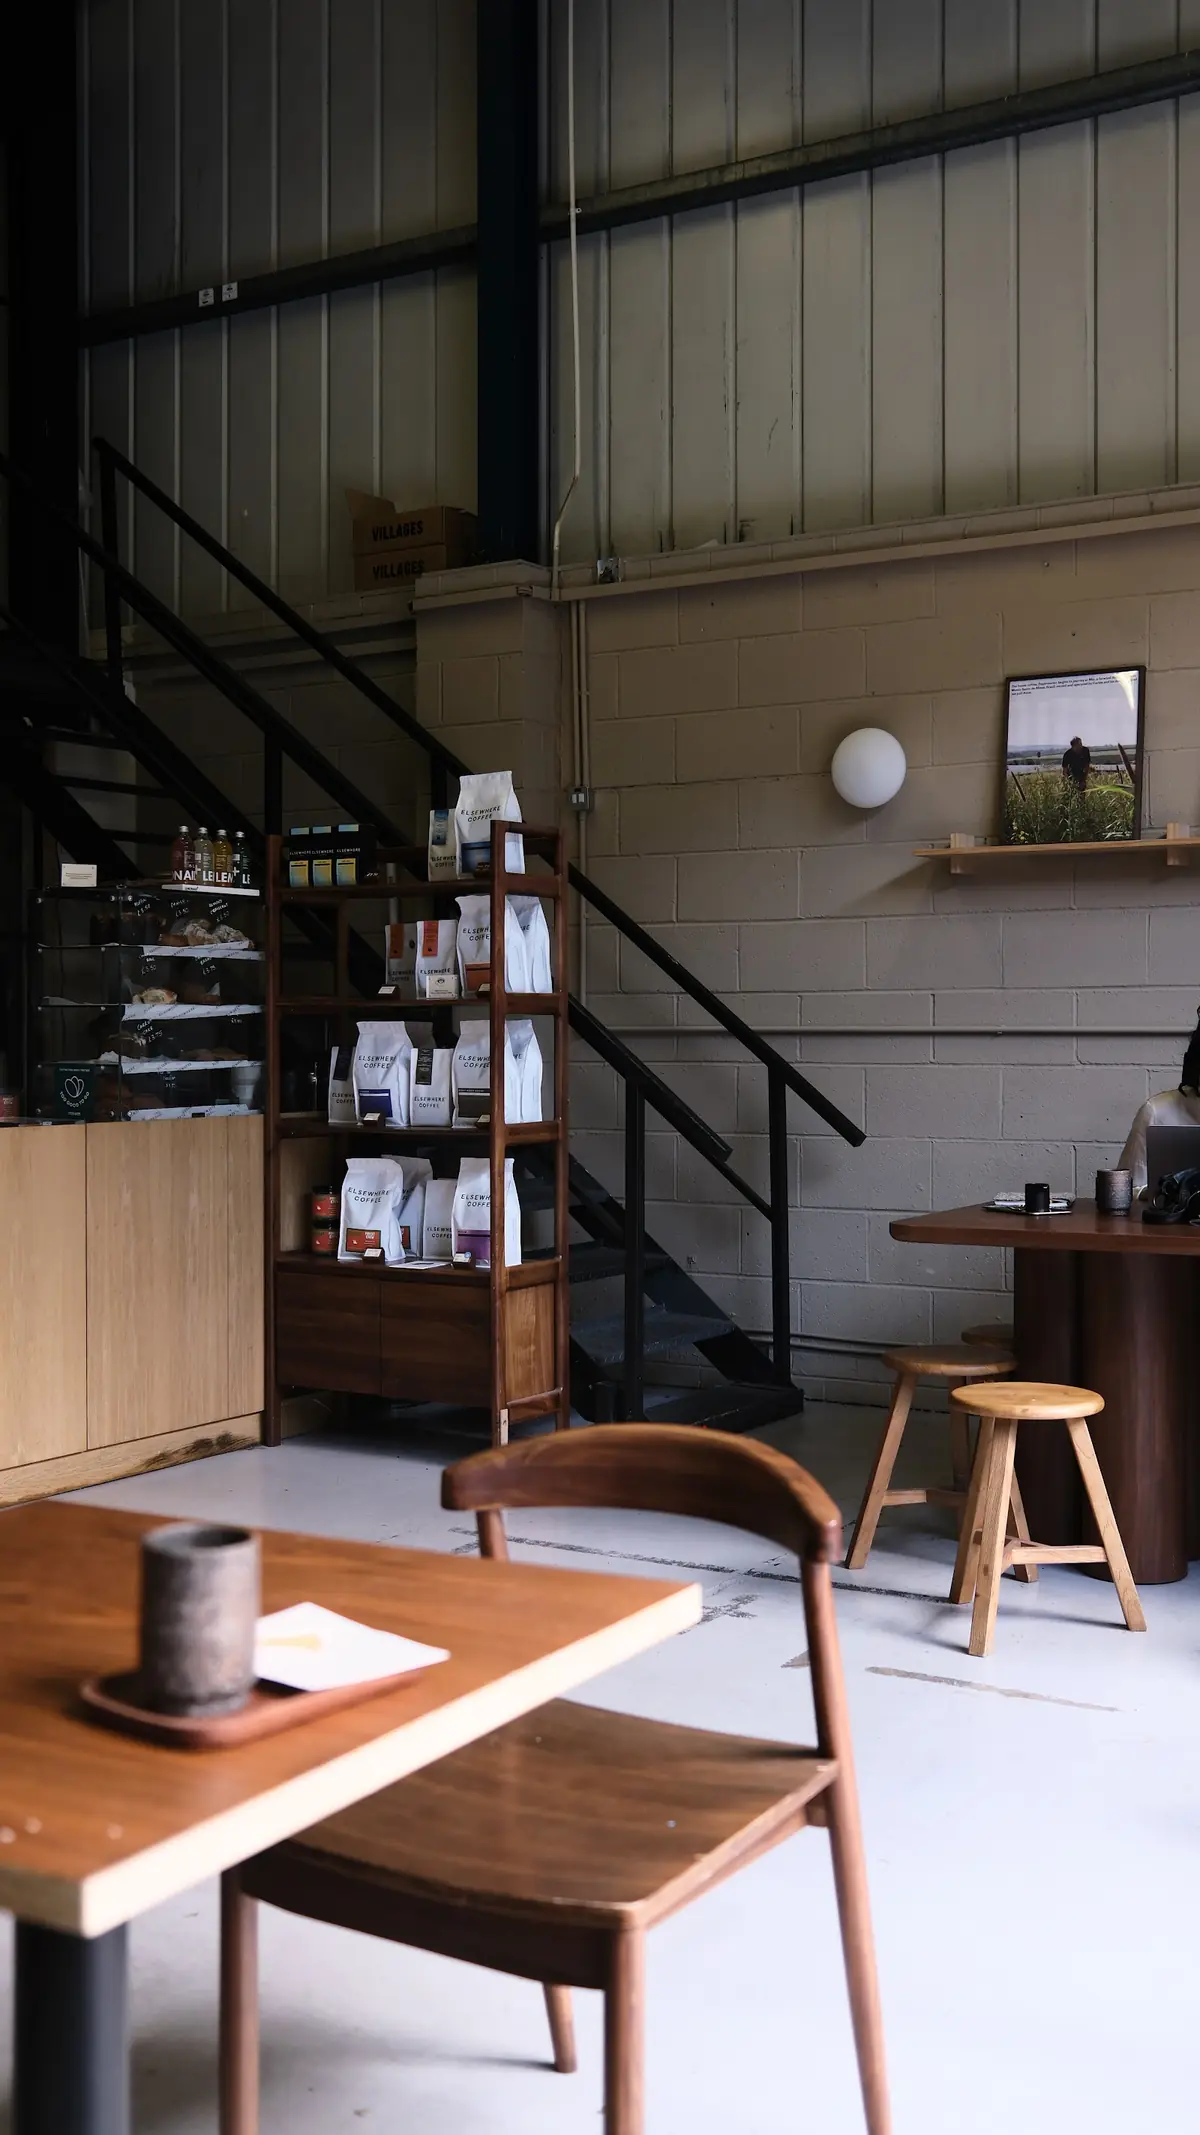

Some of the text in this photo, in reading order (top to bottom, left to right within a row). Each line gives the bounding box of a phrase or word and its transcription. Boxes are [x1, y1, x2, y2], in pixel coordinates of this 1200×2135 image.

[372, 520, 424, 542] VILLAGES
[372, 559, 425, 581] VILLAGES
[461, 805, 501, 816] ELSEWHERE
[467, 814, 492, 823] COFFEE
[347, 1187, 389, 1197] ELSEWHERE
[460, 1193, 491, 1201] ELSEWH
[354, 1196, 382, 1204] COFFEE
